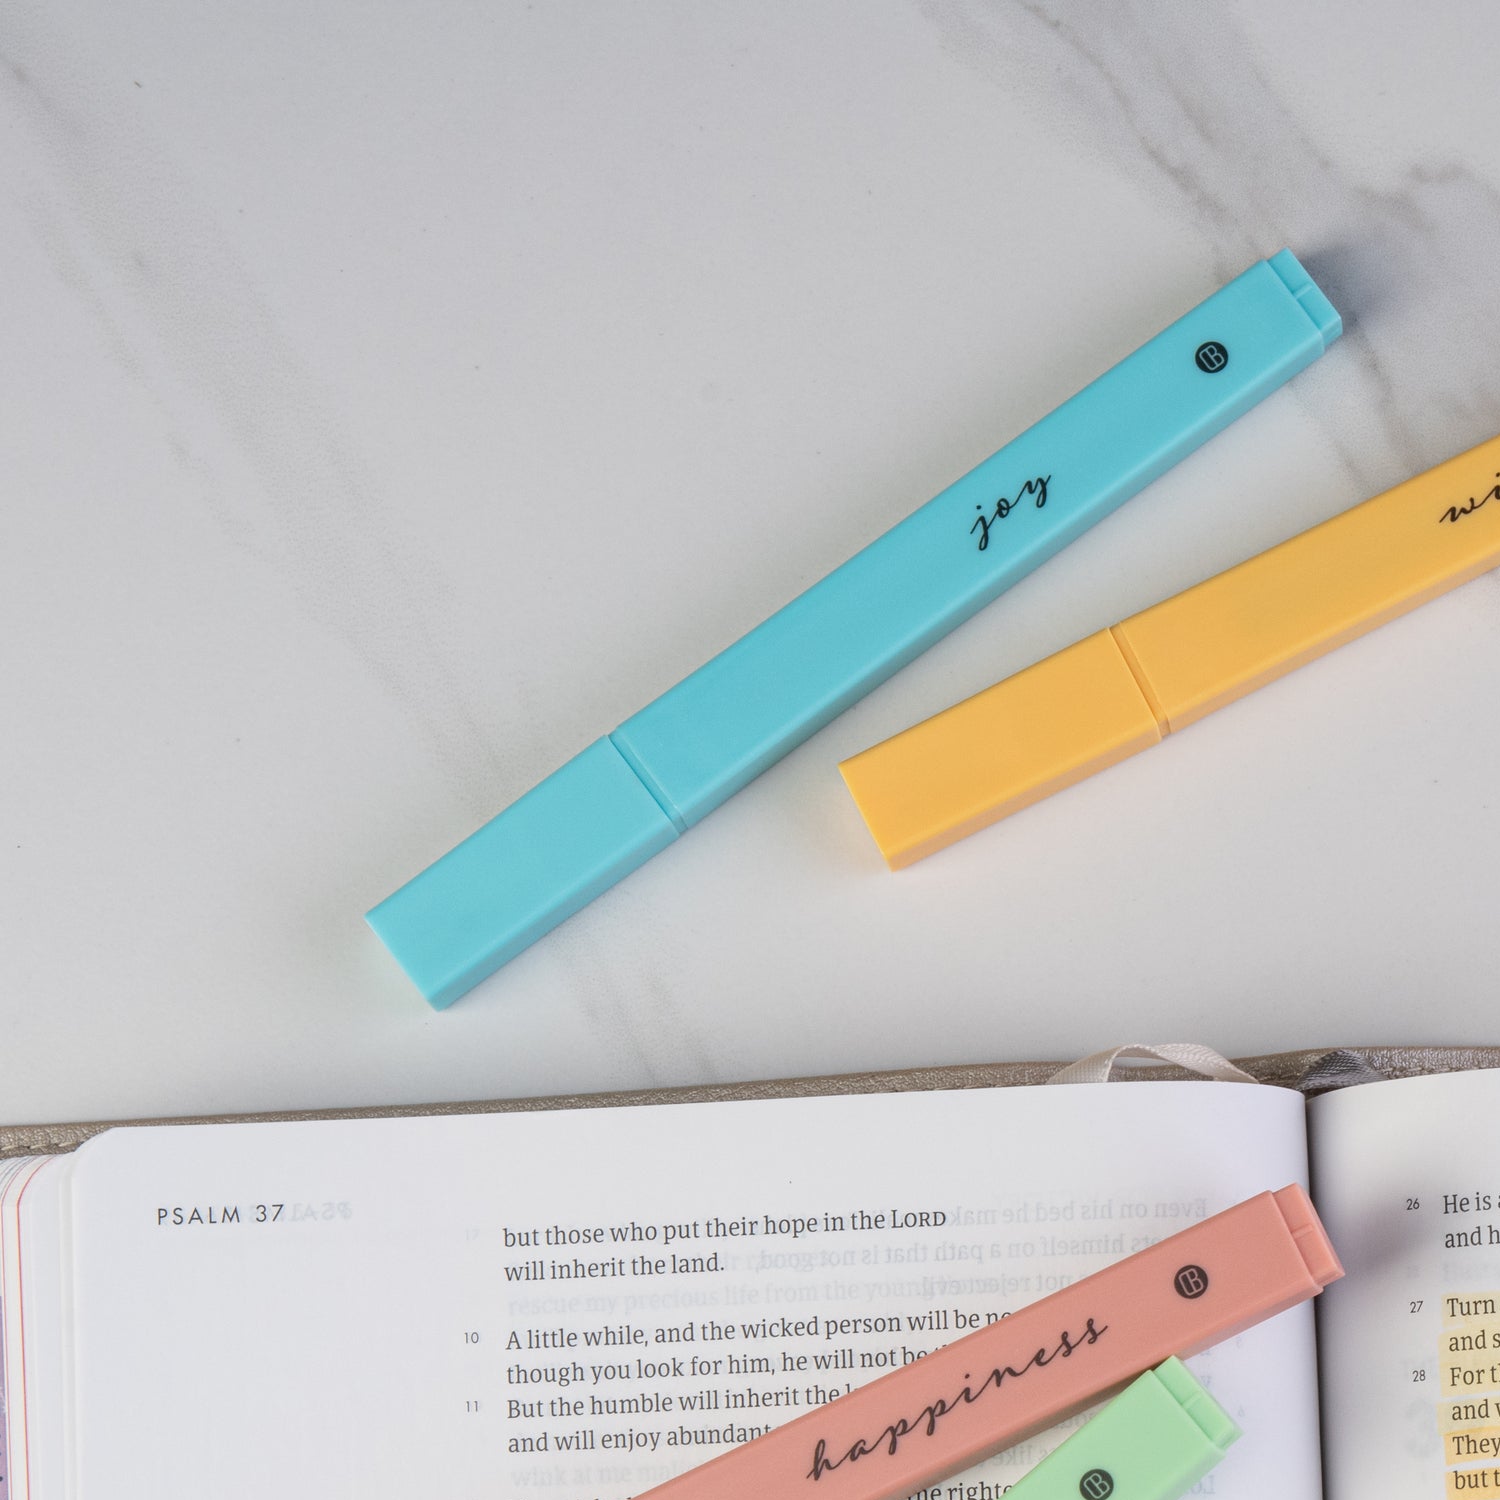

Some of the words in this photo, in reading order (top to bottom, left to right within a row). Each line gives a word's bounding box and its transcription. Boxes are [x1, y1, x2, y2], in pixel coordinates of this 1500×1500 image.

[970, 474, 1052, 552] joy
[157, 1206, 241, 1226] PSALM
[255, 1203, 285, 1223] 37
[1406, 1197, 1420, 1211] 26
[1442, 1193, 1470, 1215] He
[1474, 1191, 1492, 1212] is
[502, 1227, 540, 1248] but
[544, 1224, 605, 1246] those
[609, 1221, 658, 1243] who
[662, 1220, 701, 1246] put
[705, 1216, 759, 1238] their
[763, 1214, 818, 1239] hope
[823, 1212, 846, 1232] in
[850, 1209, 886, 1231] the
[890, 1209, 947, 1229] LORD
[1409, 1300, 1424, 1314] 27
[1446, 1297, 1497, 1318] Turn
[805, 1317, 1110, 1483] happiness
